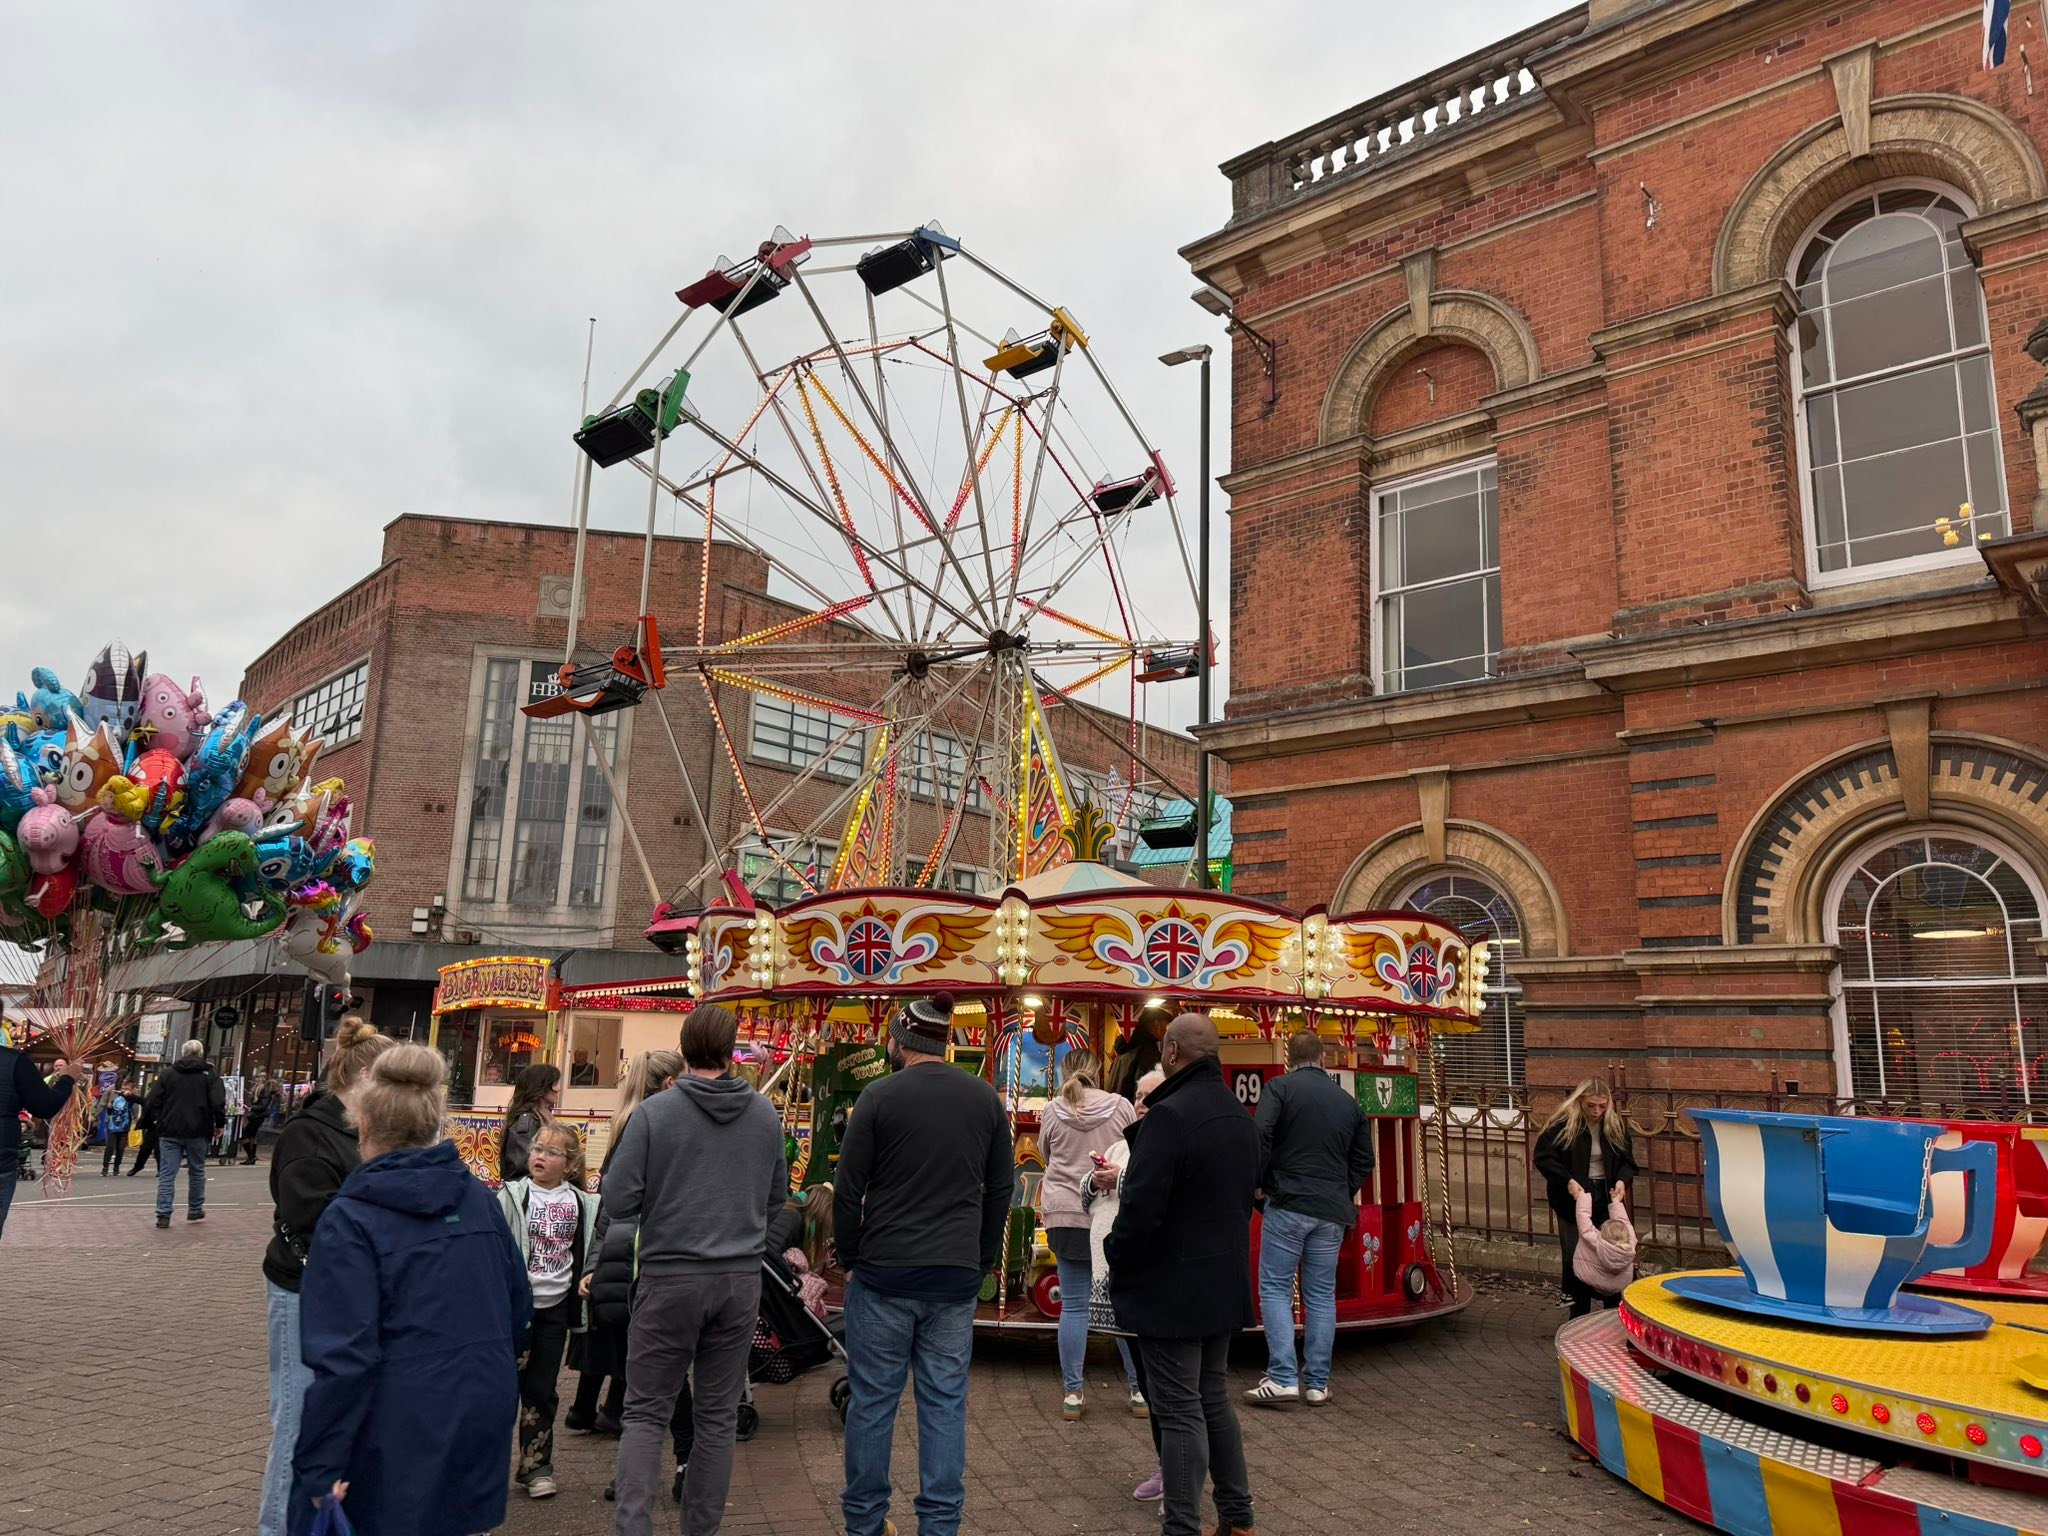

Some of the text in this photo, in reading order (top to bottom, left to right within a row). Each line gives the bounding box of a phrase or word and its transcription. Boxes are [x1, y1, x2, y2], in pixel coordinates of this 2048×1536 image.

[442, 964, 541, 1004] BIG WHEEL
[498, 1032, 515, 1048] PAY
[516, 1032, 541, 1049] HERE
[1235, 1073, 1261, 1104] 69
[529, 1221, 576, 1239] BE FREE
